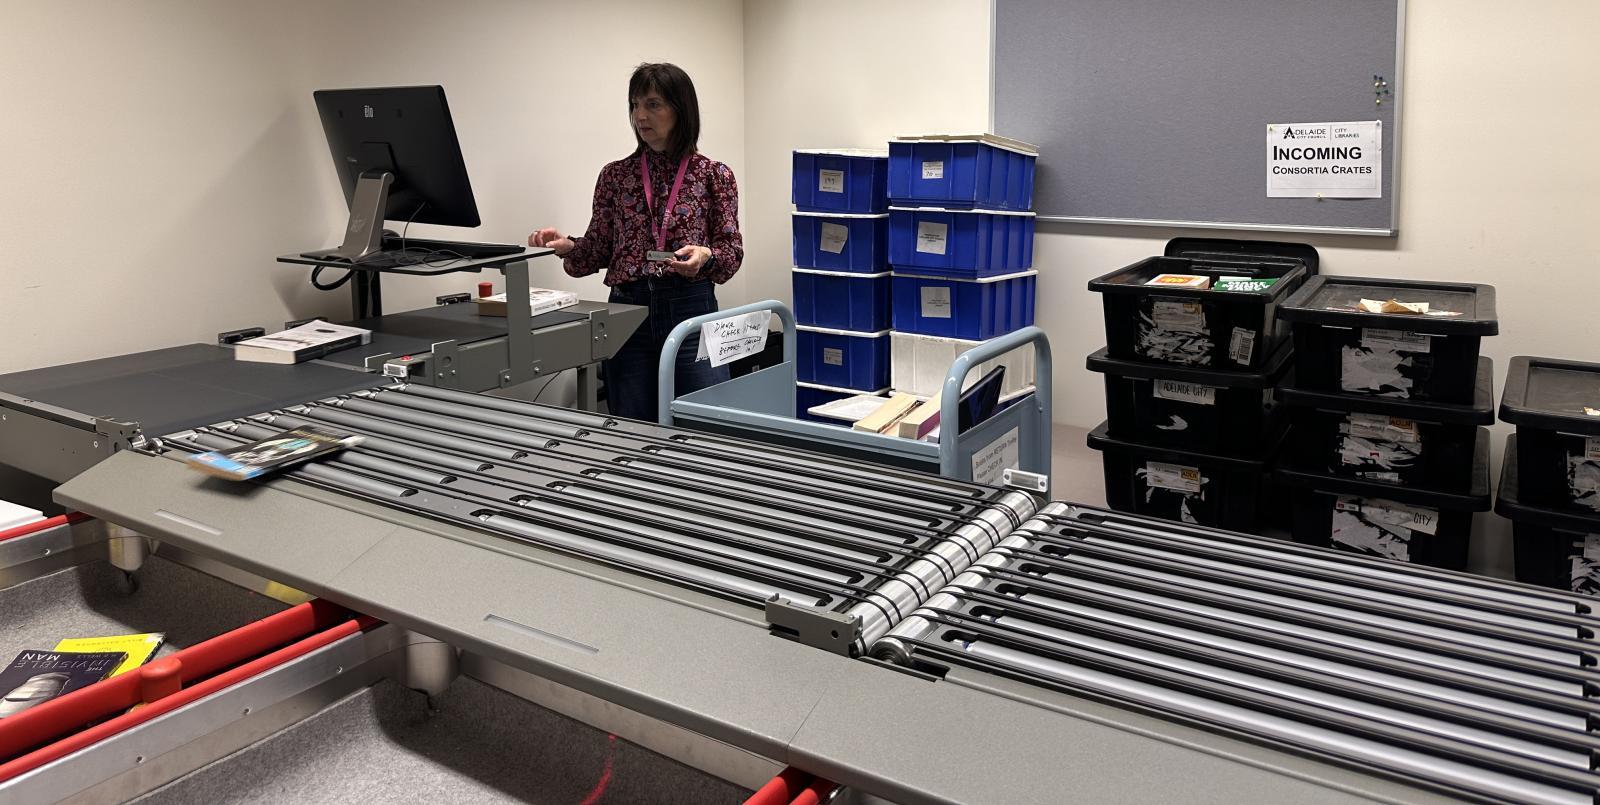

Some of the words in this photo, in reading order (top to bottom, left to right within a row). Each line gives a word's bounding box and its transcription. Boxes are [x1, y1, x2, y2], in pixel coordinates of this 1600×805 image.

[1414, 512, 1432, 526] CITY
[22, 652, 61, 661] MAN
[14, 659, 110, 669] INVISIBLE
